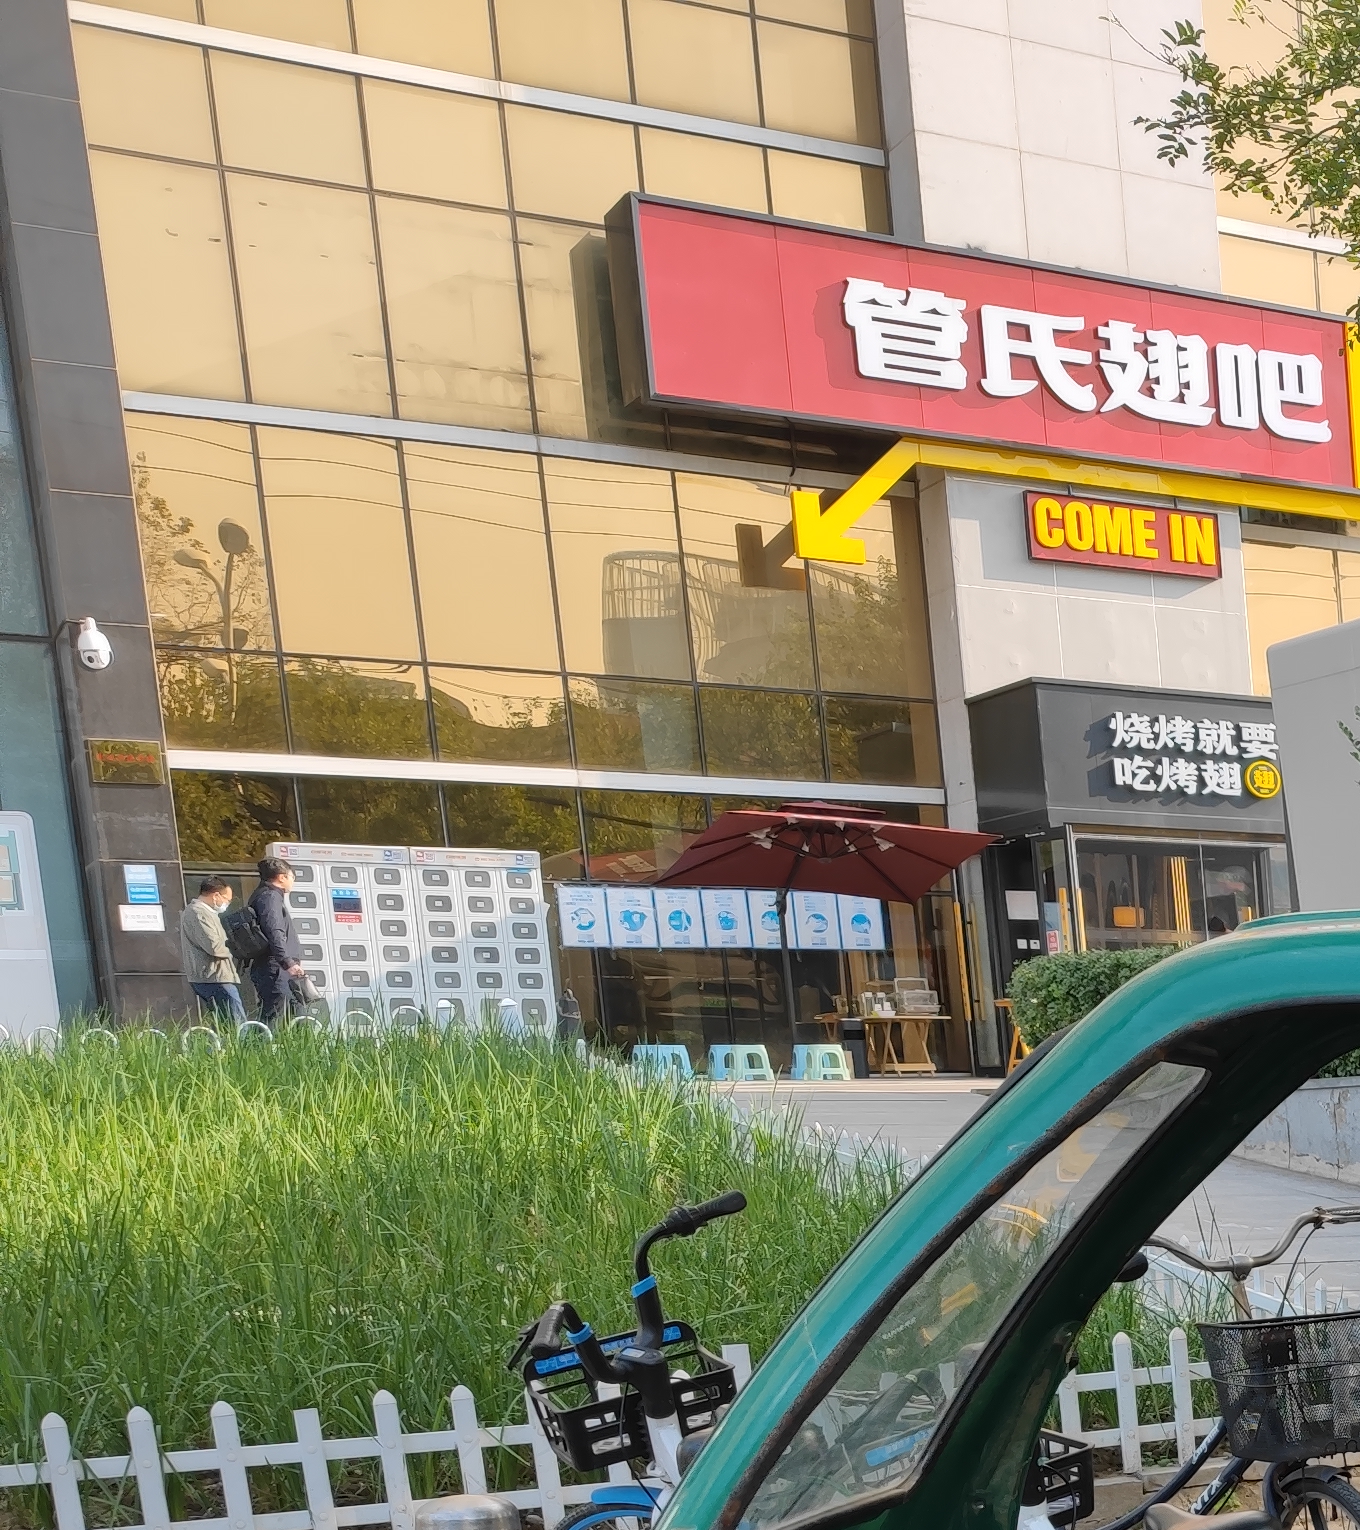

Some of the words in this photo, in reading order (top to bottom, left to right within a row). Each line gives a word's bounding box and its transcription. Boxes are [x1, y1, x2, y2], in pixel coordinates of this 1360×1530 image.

[843, 277, 1333, 444] 管氏翅吧
[1034, 497, 1159, 559] COME
[1168, 513, 1216, 566] IN
[1109, 711, 1279, 760] 烧烤就要
[1113, 754, 1242, 797] 吃烤翅
